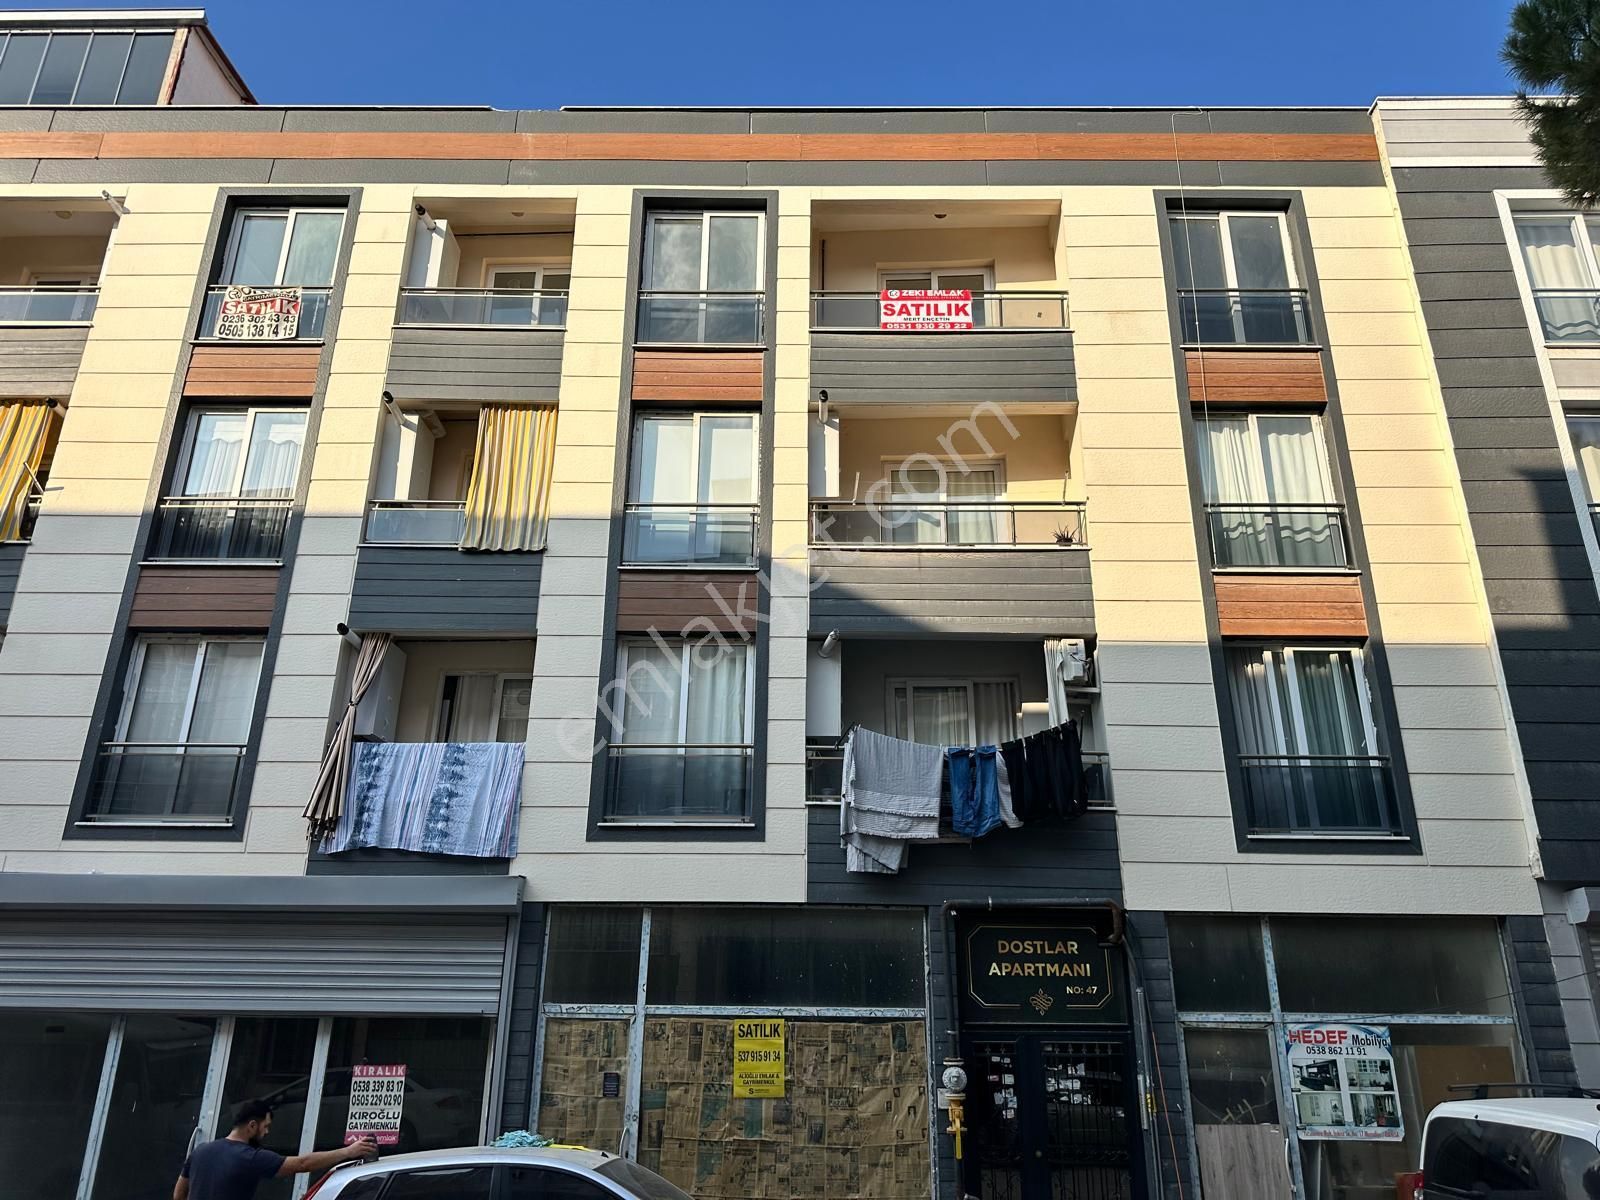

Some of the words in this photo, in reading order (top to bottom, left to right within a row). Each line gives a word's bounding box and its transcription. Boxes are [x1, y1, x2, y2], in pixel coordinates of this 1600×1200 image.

[224, 298, 298, 315] SATILIK
[883, 303, 970, 317] SATILIK
[247, 315, 266, 324] 302
[267, 314, 280, 323] 43
[283, 315, 296, 324] 43
[219, 323, 243, 337] 0505
[246, 324, 264, 337] 138
[267, 323, 280, 338] 74
[283, 324, 295, 337] 15
[997, 940, 1079, 955] DOSTLAR
[988, 962, 1091, 977] APARTMANI
[1066, 986, 1084, 995] NO:
[1086, 986, 1098, 995] 47
[738, 1023, 781, 1038] SATILIK
[1288, 1030, 1348, 1045] HEDEF
[1352, 1035, 1389, 1048] Mobilya
[738, 1050, 750, 1062] 537
[750, 1050, 763, 1062] 915
[763, 1050, 771, 1062] 91
[773, 1050, 781, 1062] 34
[1306, 1046, 1326, 1055] 0538
[1328, 1046, 1343, 1055] 862
[1345, 1047, 1355, 1056] 11
[1357, 1047, 1367, 1056] 91
[352, 1080, 371, 1093] 0538
[371, 1080, 385, 1093] 339
[385, 1080, 395, 1093] 83
[396, 1080, 404, 1093] 17
[351, 1094, 369, 1106] 0505
[369, 1094, 383, 1106] 229
[383, 1094, 392, 1106] 02
[392, 1094, 402, 1106] 90
[350, 1109, 400, 1120] KIROĞLU
[348, 1120, 399, 1130] GAYRİMENKUL
